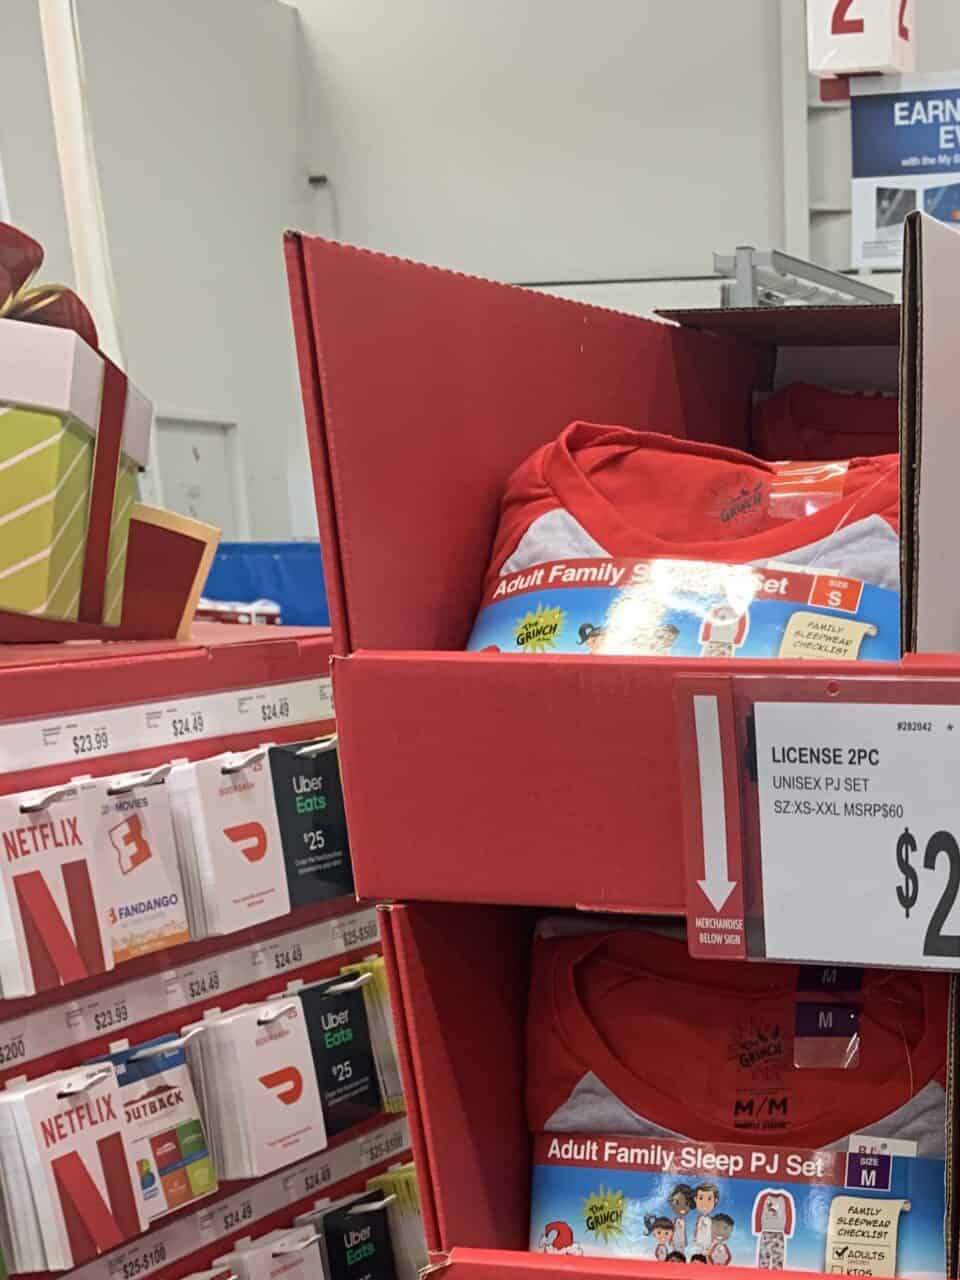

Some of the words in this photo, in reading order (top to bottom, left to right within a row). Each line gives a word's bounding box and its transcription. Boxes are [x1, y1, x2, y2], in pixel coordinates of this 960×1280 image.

[922, 156, 936, 165] the
[494, 568, 543, 598] Adult
[549, 563, 624, 589] Family
[828, 592, 842, 606] S
[515, 622, 558, 646] GRINCH
[808, 622, 844, 632] FAMILY
[261, 702, 290, 721] $24.49
[172, 716, 204, 736] $24.49
[72, 732, 109, 754] $23.99
[772, 746, 843, 766] LICENSE
[847, 748, 880, 767] 2PC
[293, 776, 323, 794] Uber
[772, 775, 823, 791] UNISEX
[826, 777, 841, 792] PJ
[845, 777, 869, 793] SET
[296, 795, 326, 813] Eats
[774, 800, 841, 817] SZ:XS-XXL
[843, 802, 904, 819] MSRP$60
[2, 816, 83, 862] NETFLIX
[304, 830, 325, 850] $25
[119, 894, 178, 919] FANDANGO
[695, 917, 744, 930] MERCHANDISE
[699, 932, 723, 943] BELOW
[725, 933, 741, 945] SIGN
[95, 1007, 128, 1030] $23.99
[321, 1010, 349, 1030] Uber
[818, 1011, 833, 1029] M
[324, 1028, 353, 1048] Eats
[332, 1062, 352, 1081] $25
[734, 1096, 789, 1116] M/M
[40, 1093, 117, 1148] NETFLIX
[547, 1139, 598, 1162] Adult
[604, 1143, 675, 1173] Family
[680, 1147, 743, 1177] Sleep
[751, 1152, 778, 1175] PJ
[786, 1154, 824, 1178] Set
[860, 1158, 880, 1166] SIZE
[860, 1169, 876, 1186] M
[585, 1205, 625, 1231] GRINCH
[848, 1205, 882, 1216] FAMILY
[837, 1217, 891, 1228] SLEEPWEAR
[344, 1226, 372, 1249] Uber
[837, 1228, 888, 1240] CHECKLIST
[848, 1250, 885, 1261] ADULTS
